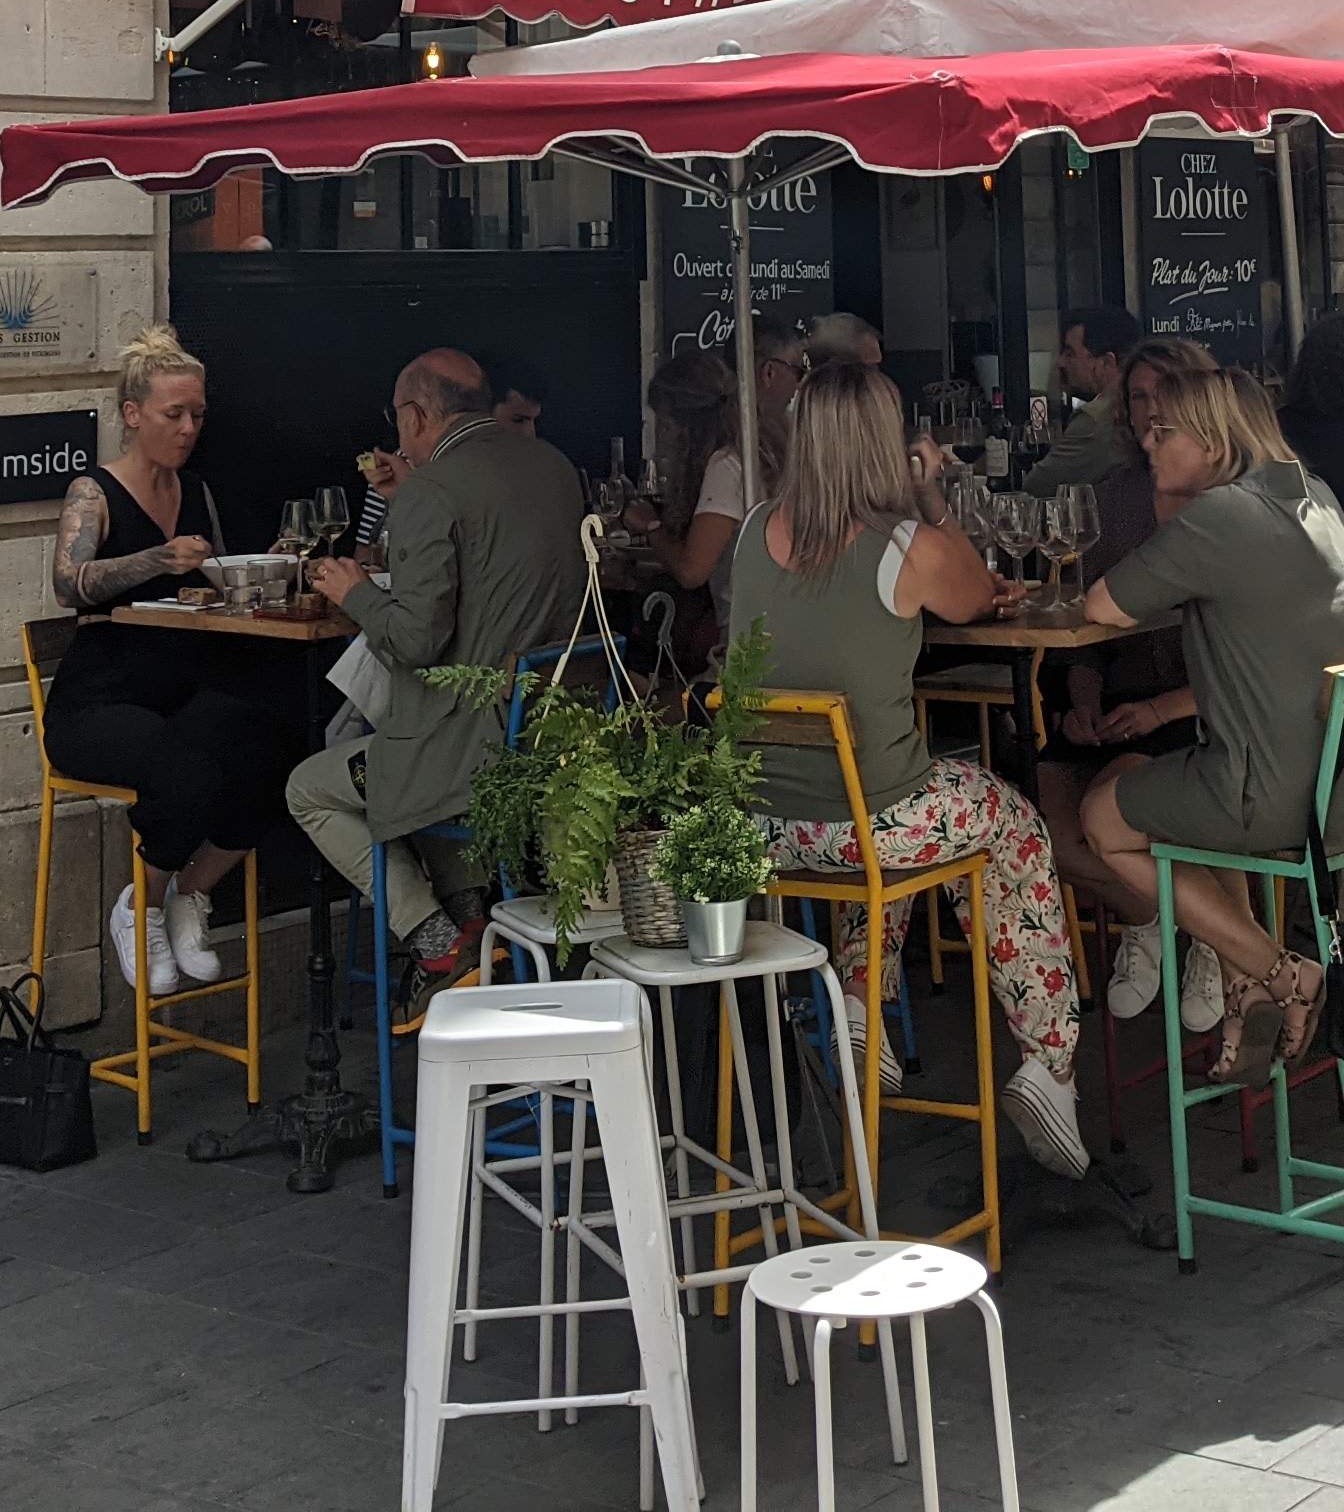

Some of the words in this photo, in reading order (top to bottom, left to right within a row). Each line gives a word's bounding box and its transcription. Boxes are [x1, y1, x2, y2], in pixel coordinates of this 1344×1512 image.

[1180, 153, 1217, 174] CHEZ
[1152, 176, 1249, 220] Lolotte
[673, 252, 723, 278] Ouvert
[780, 264, 795, 279] au
[795, 259, 831, 280] Samedi
[1151, 257, 1180, 287] Plat
[1181, 260, 1198, 285] du
[1235, 258, 1257, 283] 10€
[756, 285, 769, 301] de
[697, 309, 736, 350] Côt
[1151, 316, 1180, 333] Lundi
[13, 331, 61, 344] GESTION
